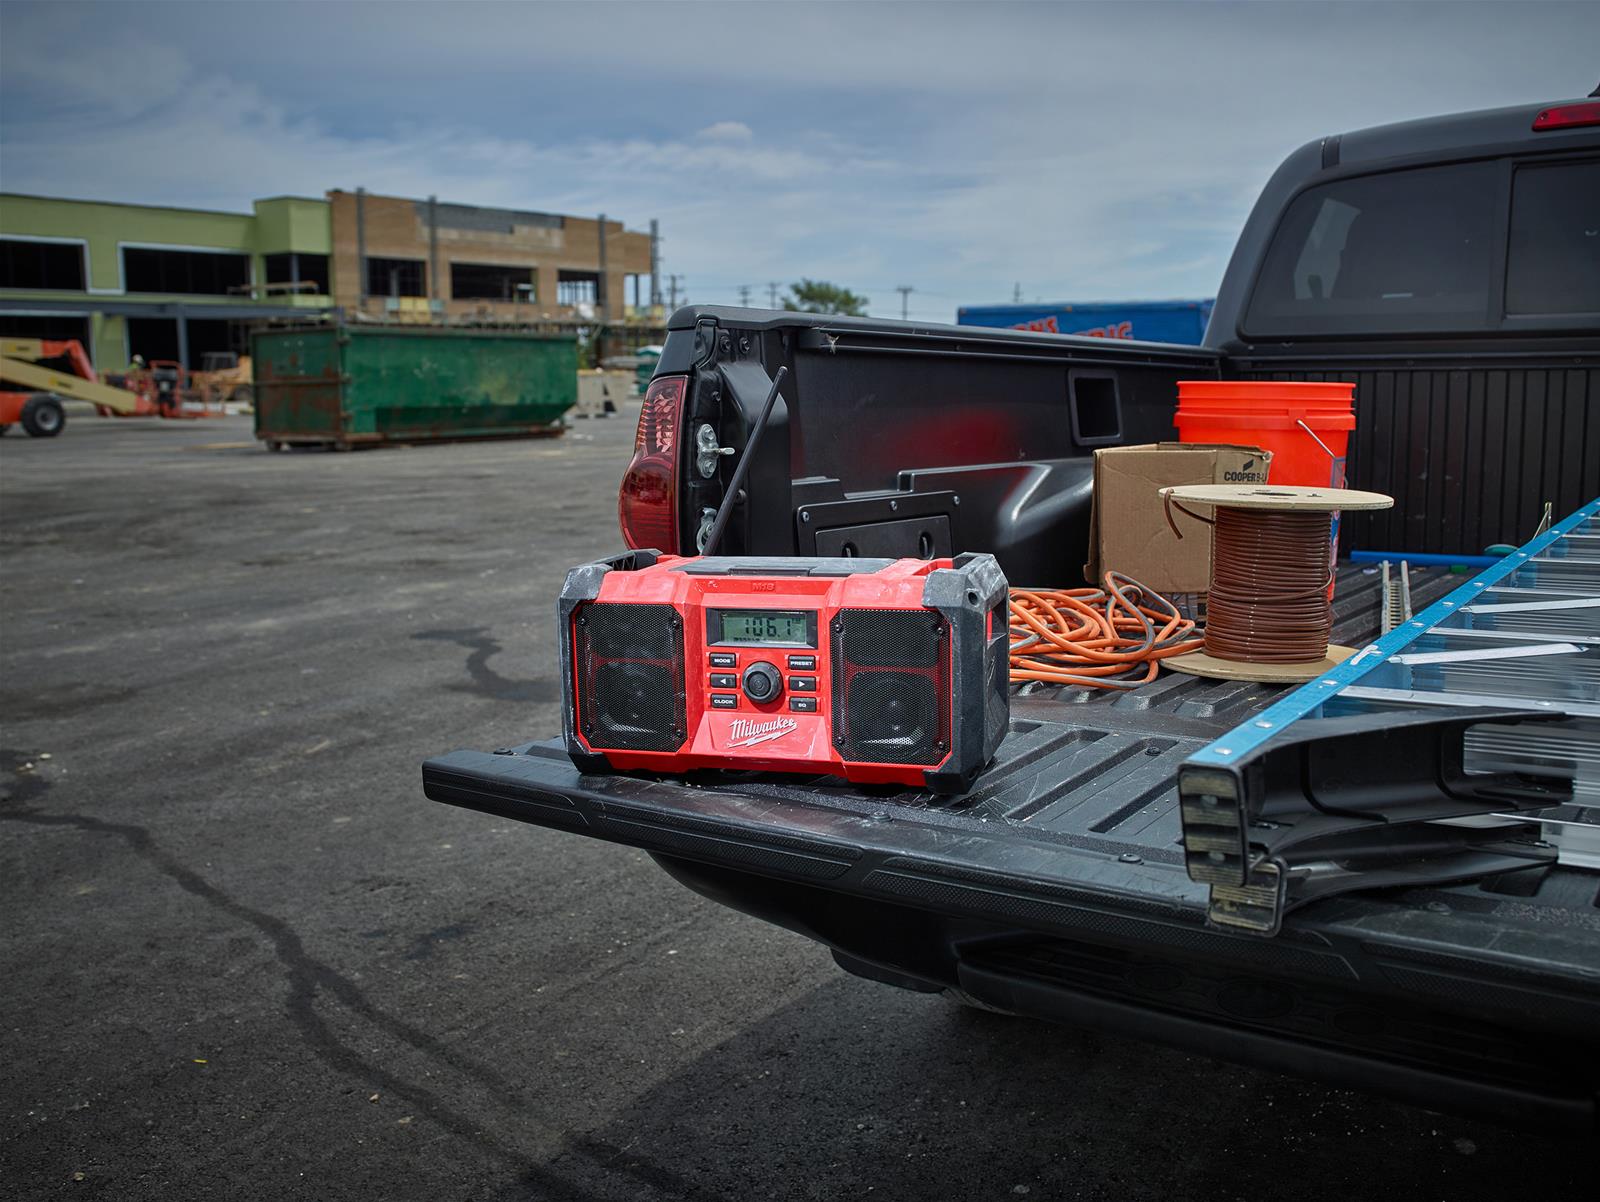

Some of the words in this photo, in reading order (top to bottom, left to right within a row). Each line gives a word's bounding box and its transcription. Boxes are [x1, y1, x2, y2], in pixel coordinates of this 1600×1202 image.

[1224, 471, 1256, 482] COOPER
[752, 582, 775, 591] M18
[745, 617, 791, 637] 106.1
[729, 716, 797, 741] Milwaukee
